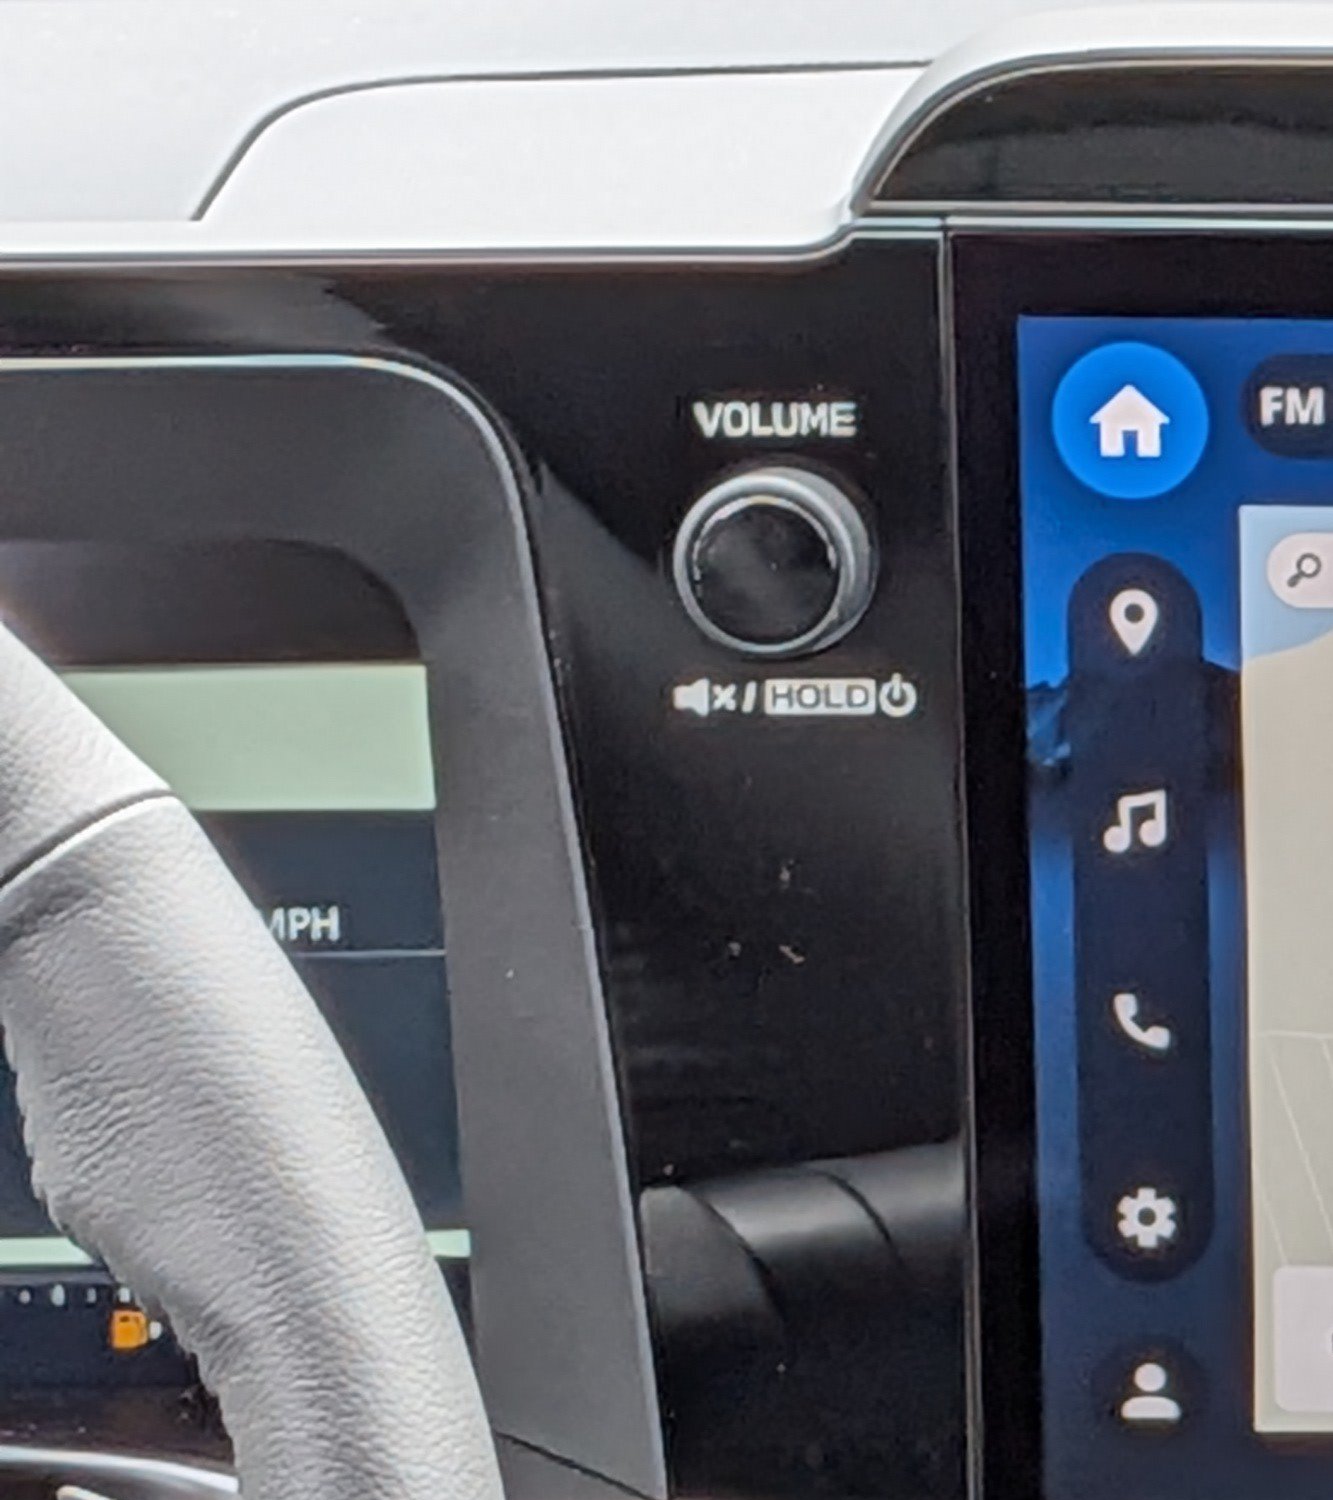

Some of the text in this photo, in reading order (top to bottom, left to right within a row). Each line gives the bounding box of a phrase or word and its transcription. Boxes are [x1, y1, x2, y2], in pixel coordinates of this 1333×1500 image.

[692, 400, 857, 439] VOLUME
[1259, 385, 1326, 427] FM
[769, 683, 870, 711] HOLD
